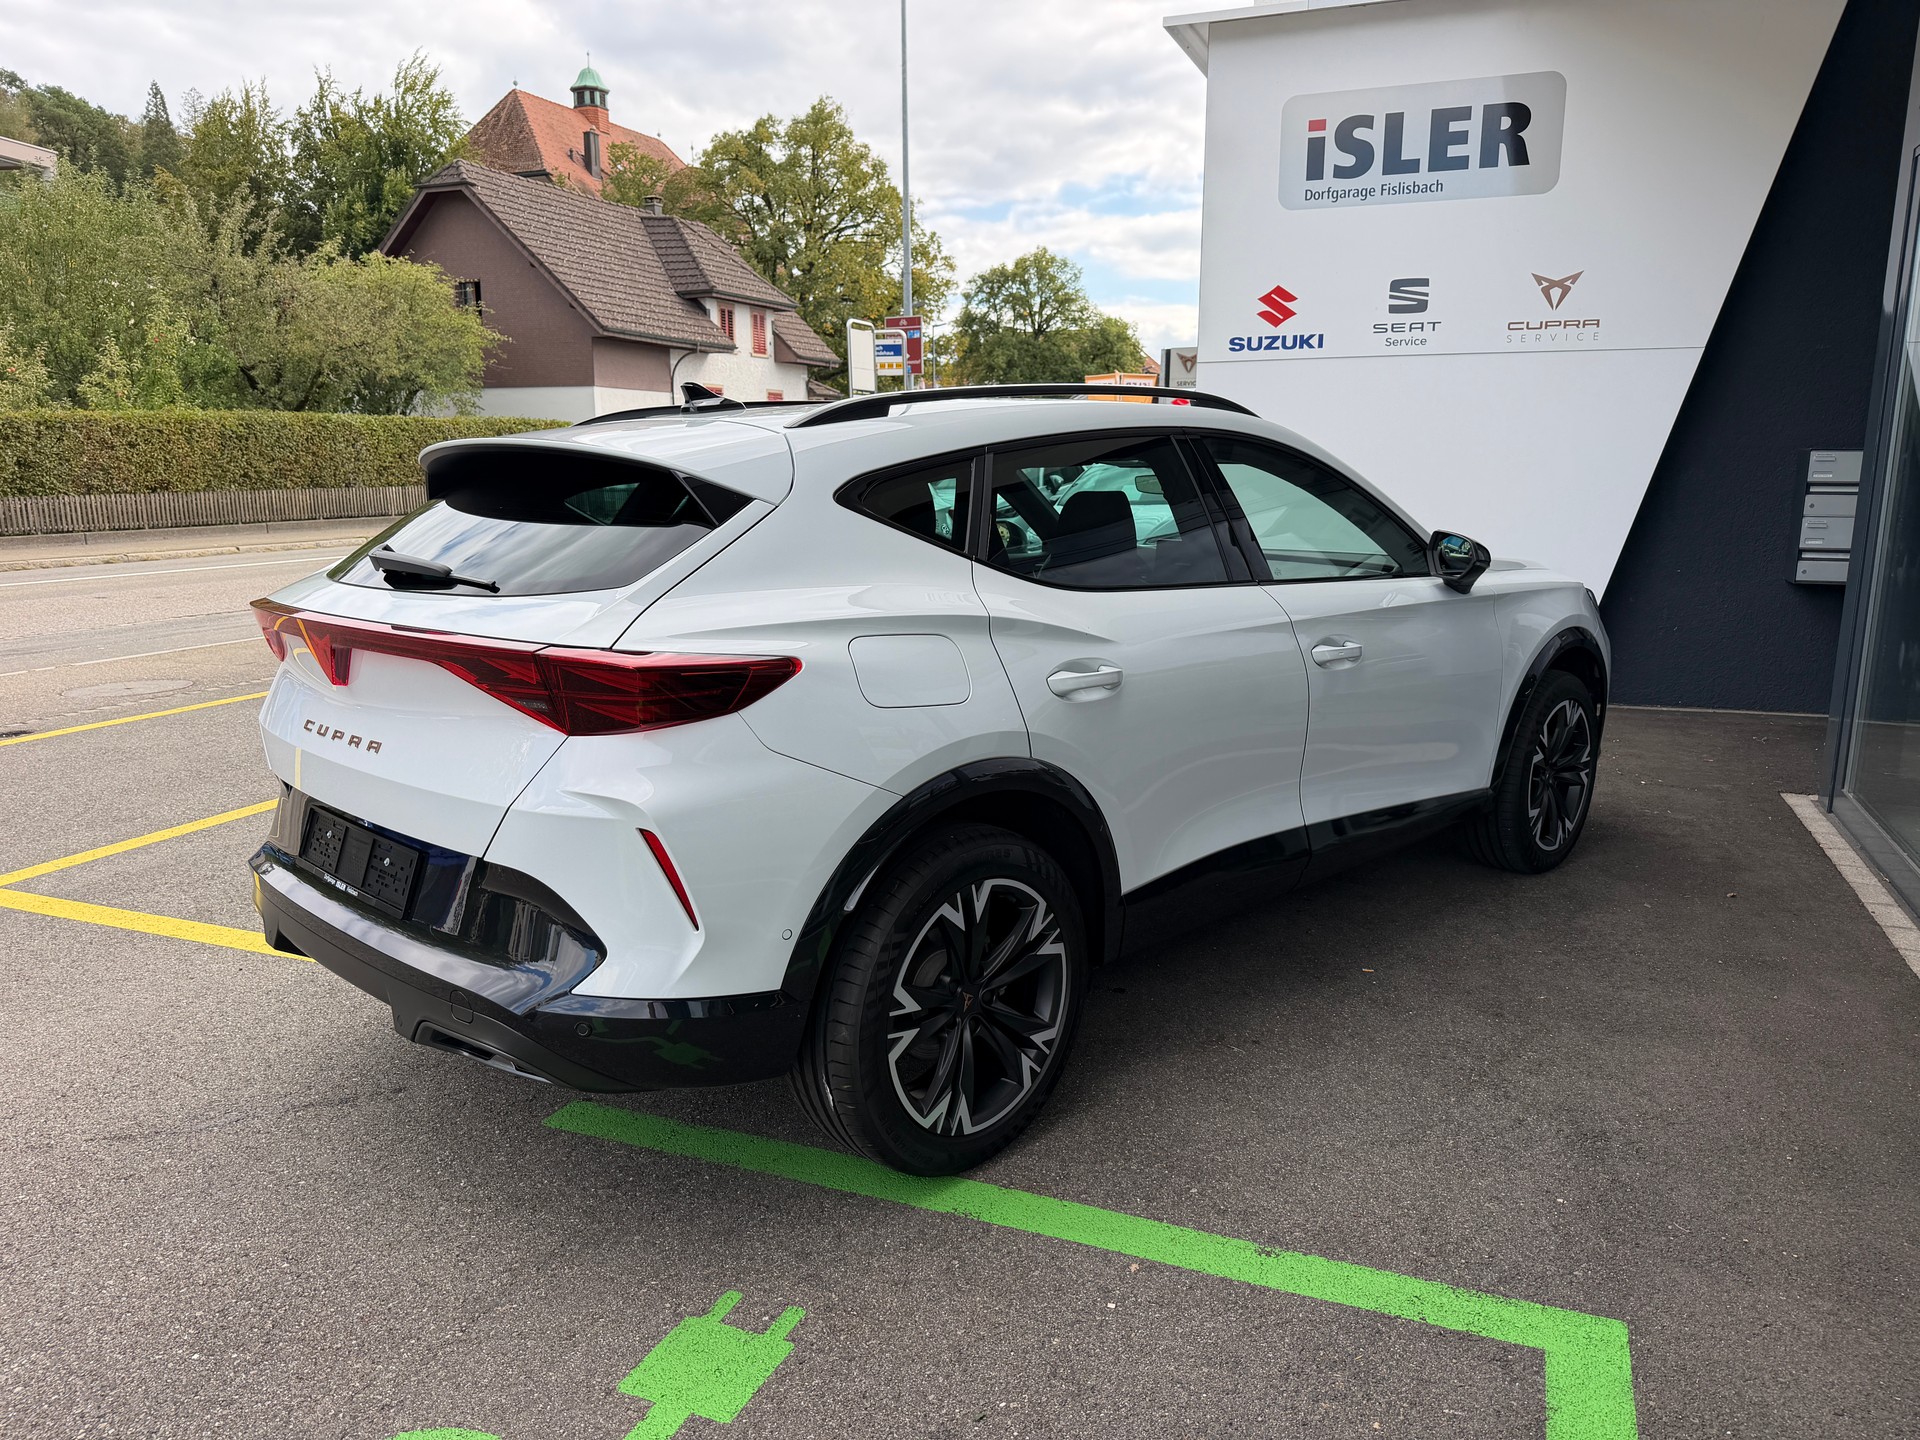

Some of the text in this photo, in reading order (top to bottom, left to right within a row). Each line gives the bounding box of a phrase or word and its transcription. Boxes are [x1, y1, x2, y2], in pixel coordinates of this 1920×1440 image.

[1304, 179, 1444, 203] Dorfgarage Fislisbach
[1372, 321, 1442, 334] SEAT
[1507, 318, 1601, 331] CUPRA
[1228, 333, 1325, 353] SUZUKI
[1384, 336, 1428, 347] Service
[1506, 331, 1600, 344] SERVICE
[303, 718, 383, 755] CUPRA
